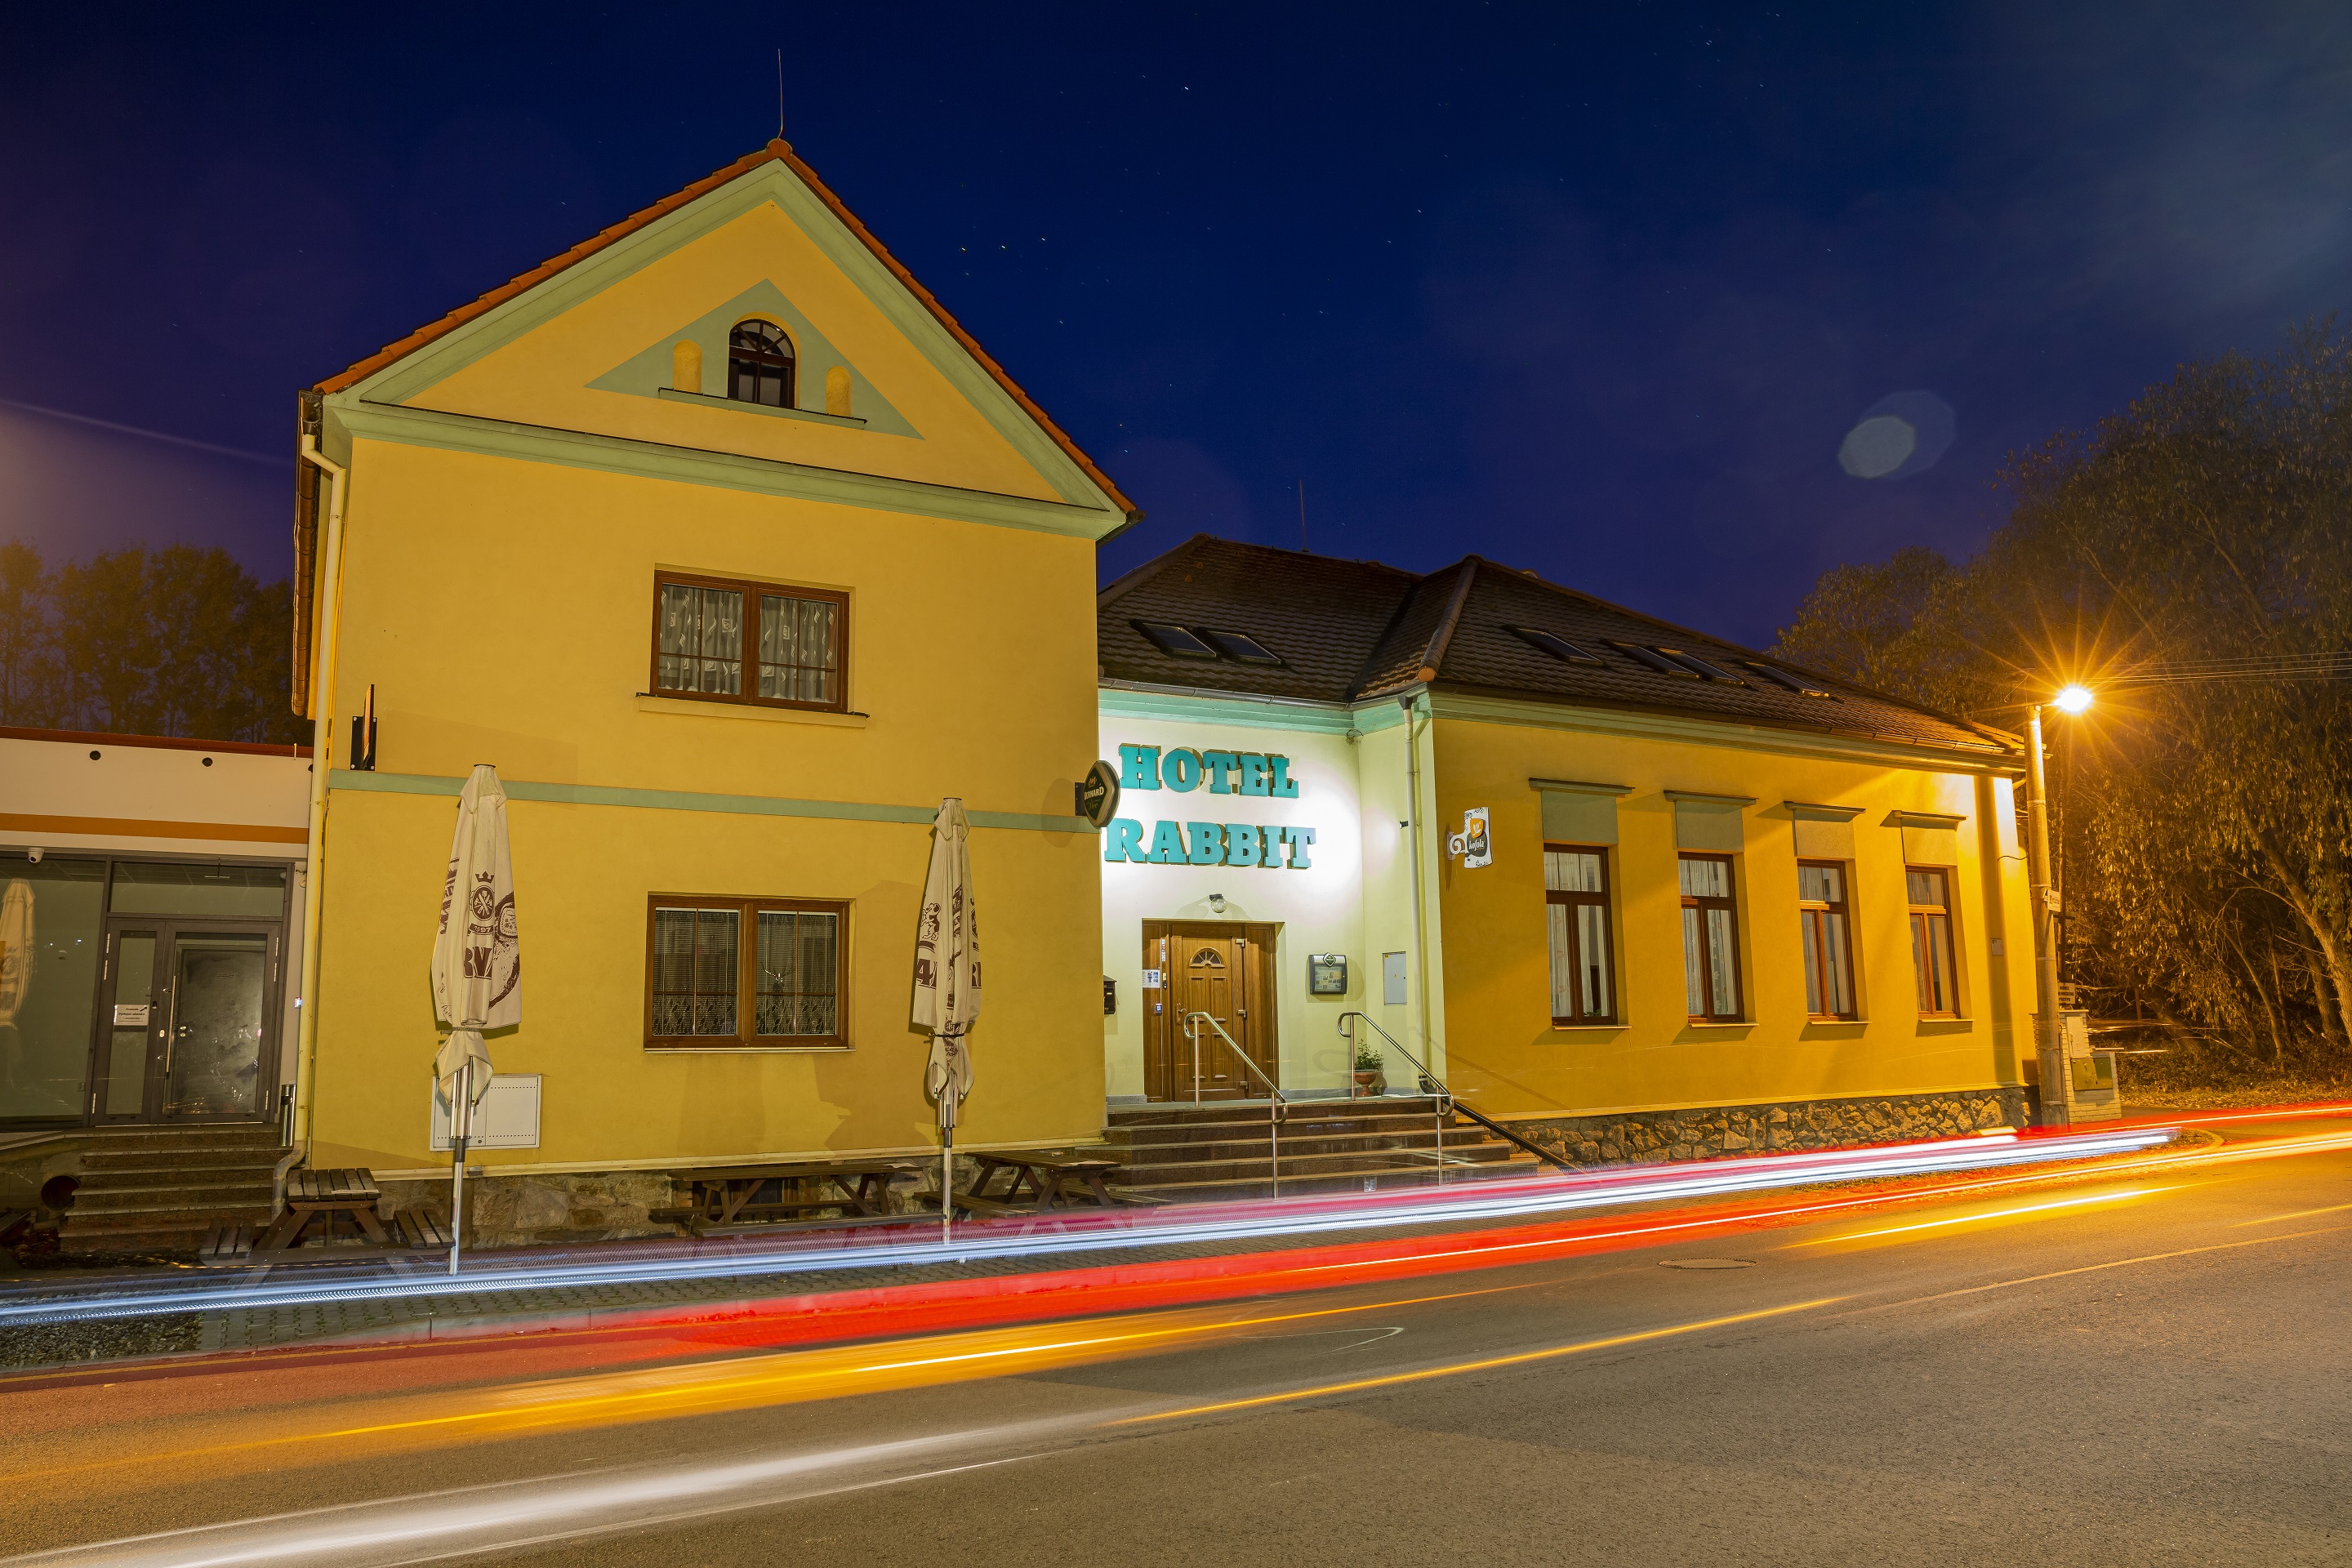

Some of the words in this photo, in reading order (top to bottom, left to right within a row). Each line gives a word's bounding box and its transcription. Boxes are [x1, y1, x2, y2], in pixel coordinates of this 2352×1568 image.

[1118, 746, 1298, 798] HOTEL
[1104, 817, 1316, 868] RABBIT
[1468, 839, 1485, 851] kofola
